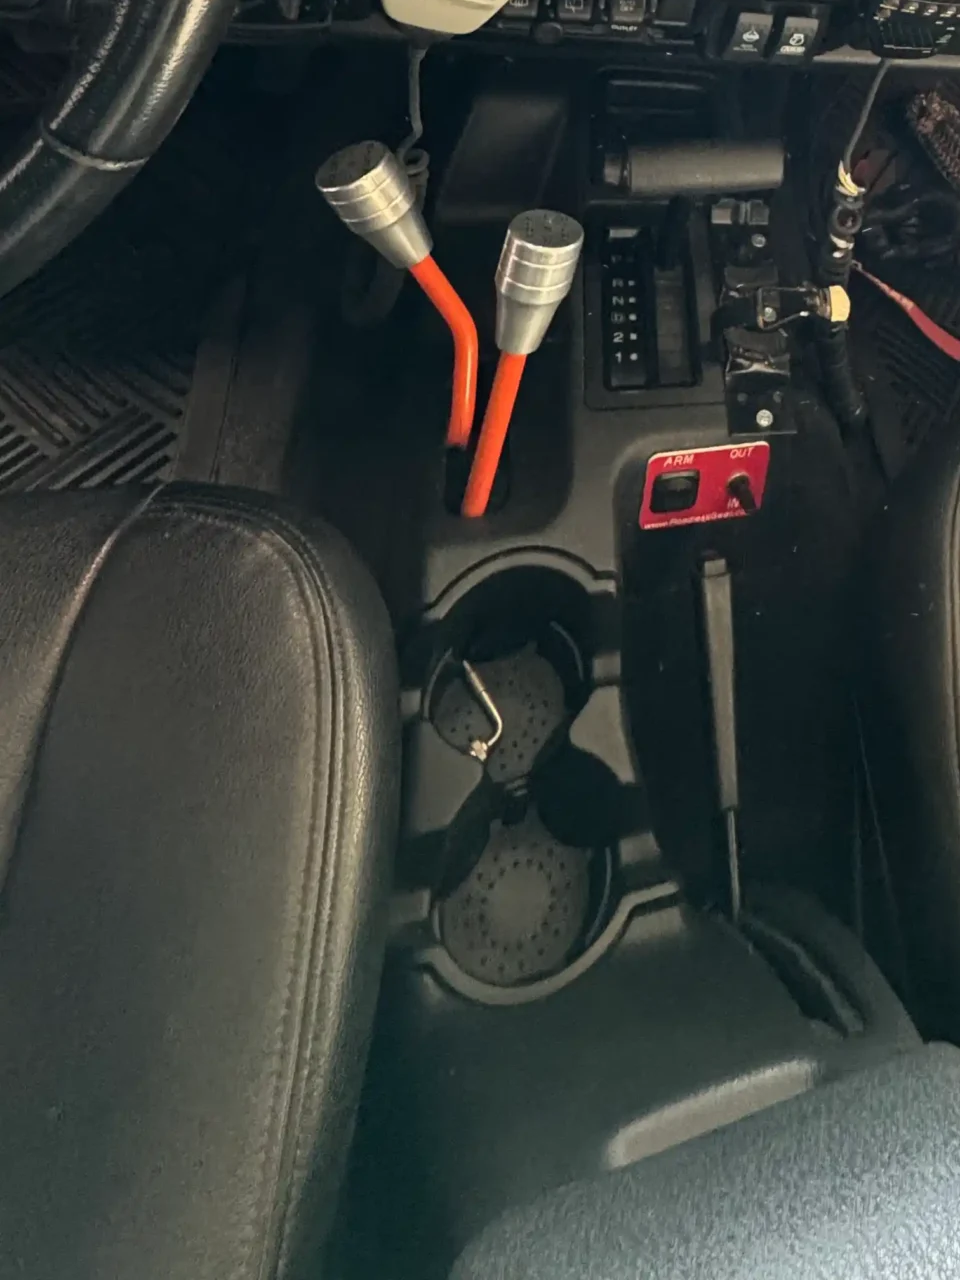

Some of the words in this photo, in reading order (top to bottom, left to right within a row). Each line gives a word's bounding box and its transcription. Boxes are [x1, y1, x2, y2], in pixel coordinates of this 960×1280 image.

[611, 296, 625, 306] N
[612, 331, 625, 343] 2
[614, 351, 623, 363] 1
[729, 447, 755, 459] OUT
[663, 454, 695, 468] ARM
